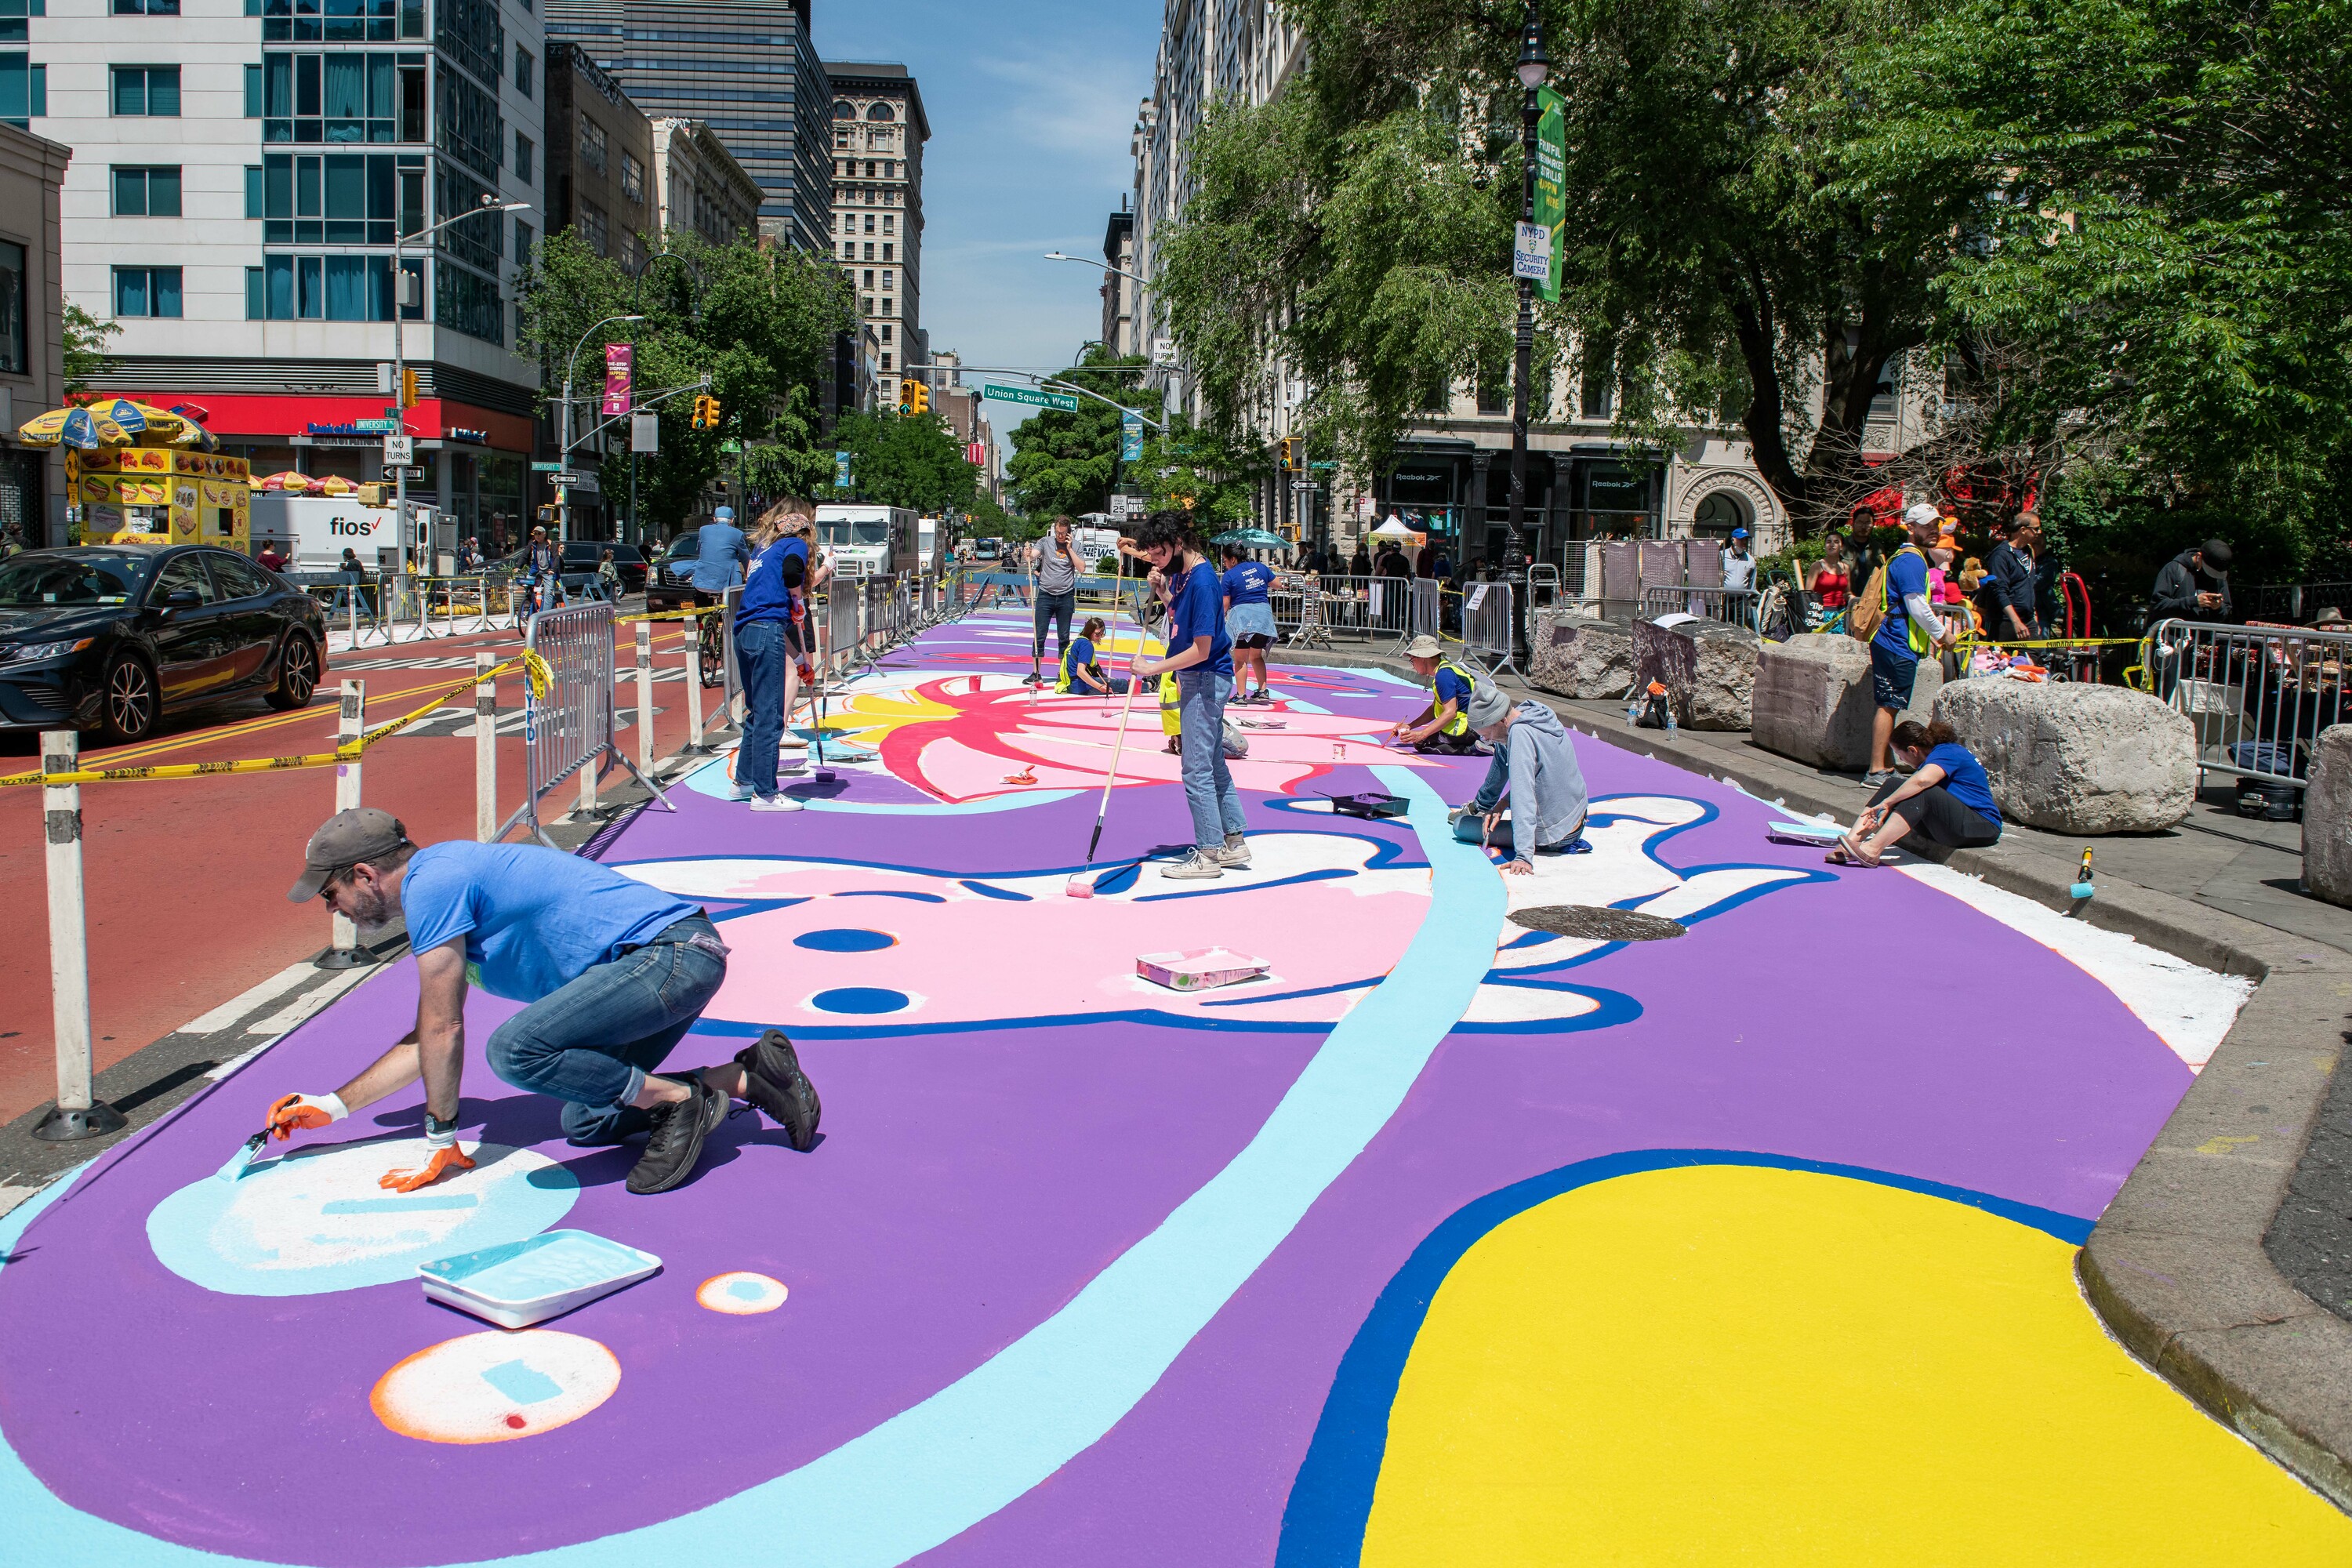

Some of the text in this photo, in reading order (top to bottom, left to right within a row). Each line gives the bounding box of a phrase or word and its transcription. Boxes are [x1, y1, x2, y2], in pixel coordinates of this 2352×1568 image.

[1522, 226, 1545, 240] NYPD
[988, 387, 1073, 408] Union Square West
[308, 422, 332, 433] Bank
[333, 422, 347, 433] of
[356, 420, 387, 429] UNIVERSITY
[387, 452, 411, 460] TURNS
[330, 517, 372, 535] fios
[1083, 548, 1116, 557] NEWS
[525, 677, 535, 742] NYPD
